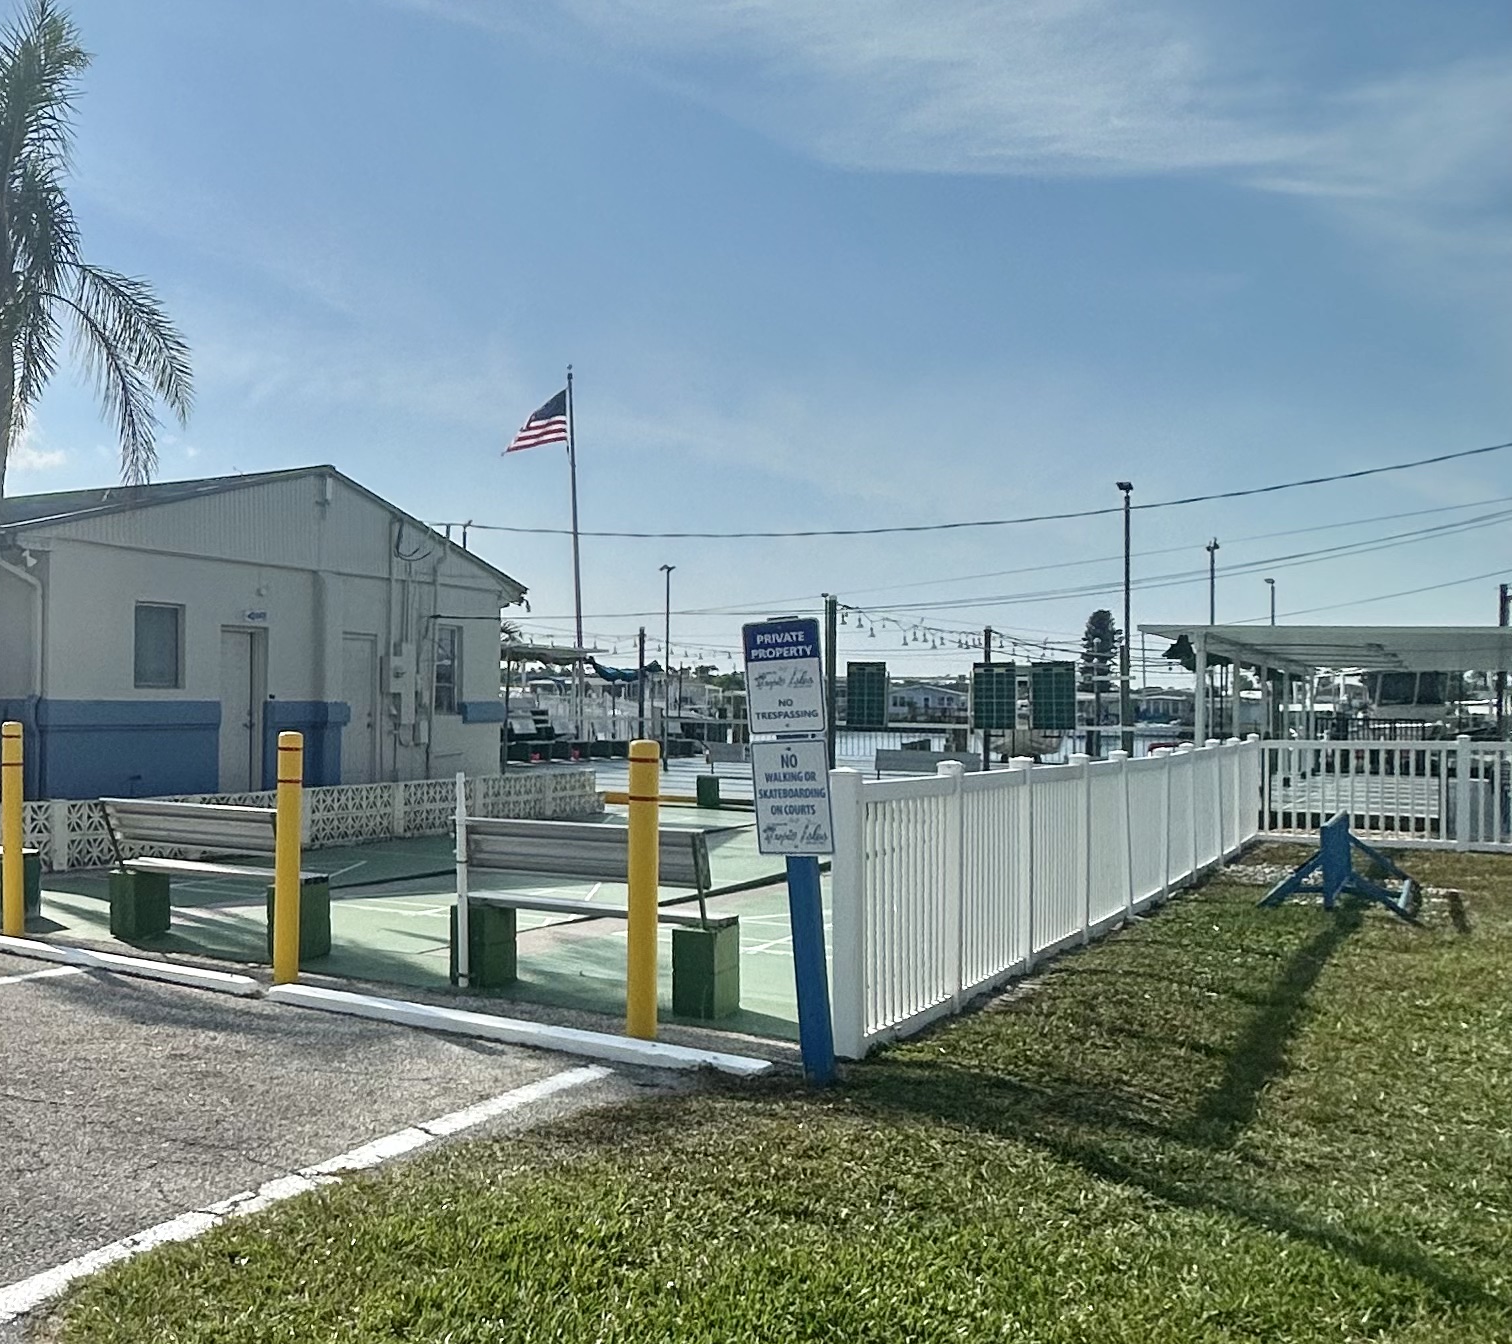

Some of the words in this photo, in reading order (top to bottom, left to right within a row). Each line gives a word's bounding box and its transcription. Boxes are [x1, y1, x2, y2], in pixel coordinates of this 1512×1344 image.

[756, 631, 805, 645] PRIVATE
[751, 644, 813, 659] PROPERTY
[778, 698, 793, 707] NO
[755, 709, 819, 720] TRESPASSING
[780, 754, 798, 768] NO
[764, 771, 803, 783] WALKING
[804, 771, 817, 782] OR
[758, 786, 826, 799] SKATEBOARDING
[770, 805, 783, 815] ON
[784, 804, 816, 815] COURTS
